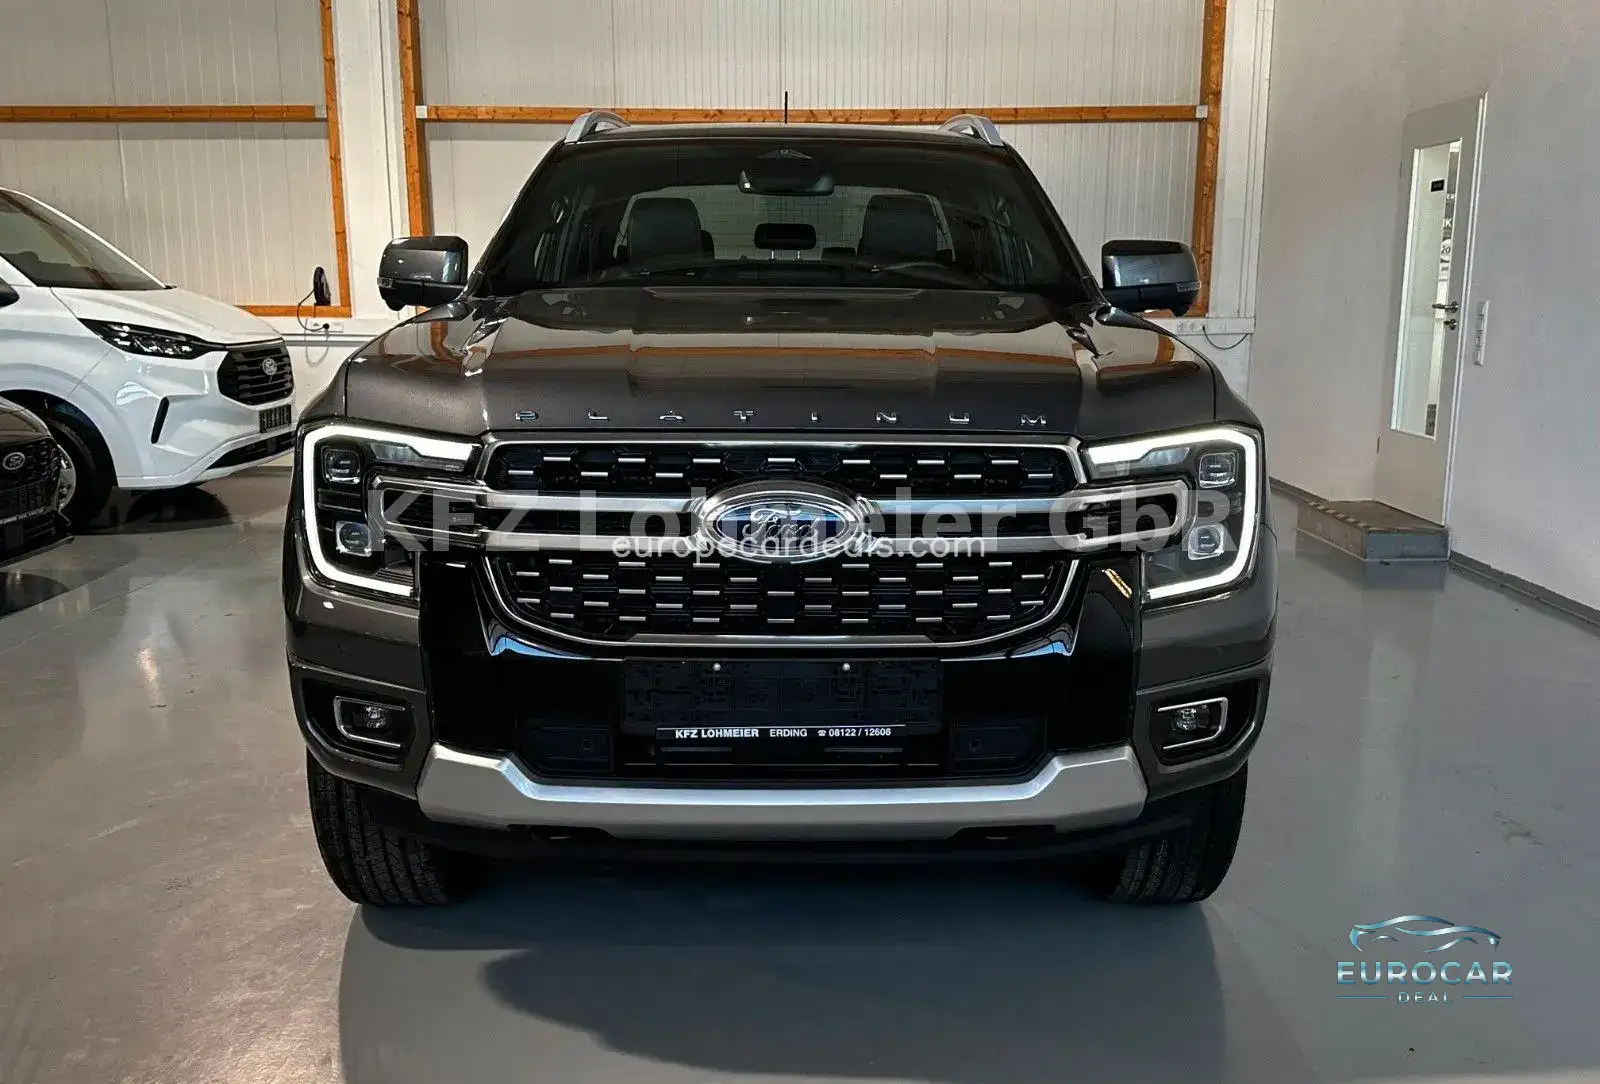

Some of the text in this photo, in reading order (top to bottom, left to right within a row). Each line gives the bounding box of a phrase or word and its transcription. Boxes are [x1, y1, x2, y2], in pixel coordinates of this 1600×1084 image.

[515, 409, 1047, 425] PLATINUM
[742, 507, 821, 538] Ford
[675, 729, 699, 739] KFZ
[701, 728, 760, 738] LOHMEIER
[769, 728, 808, 738] ERDING
[828, 727, 856, 737] 08122
[864, 727, 892, 737] 12608
